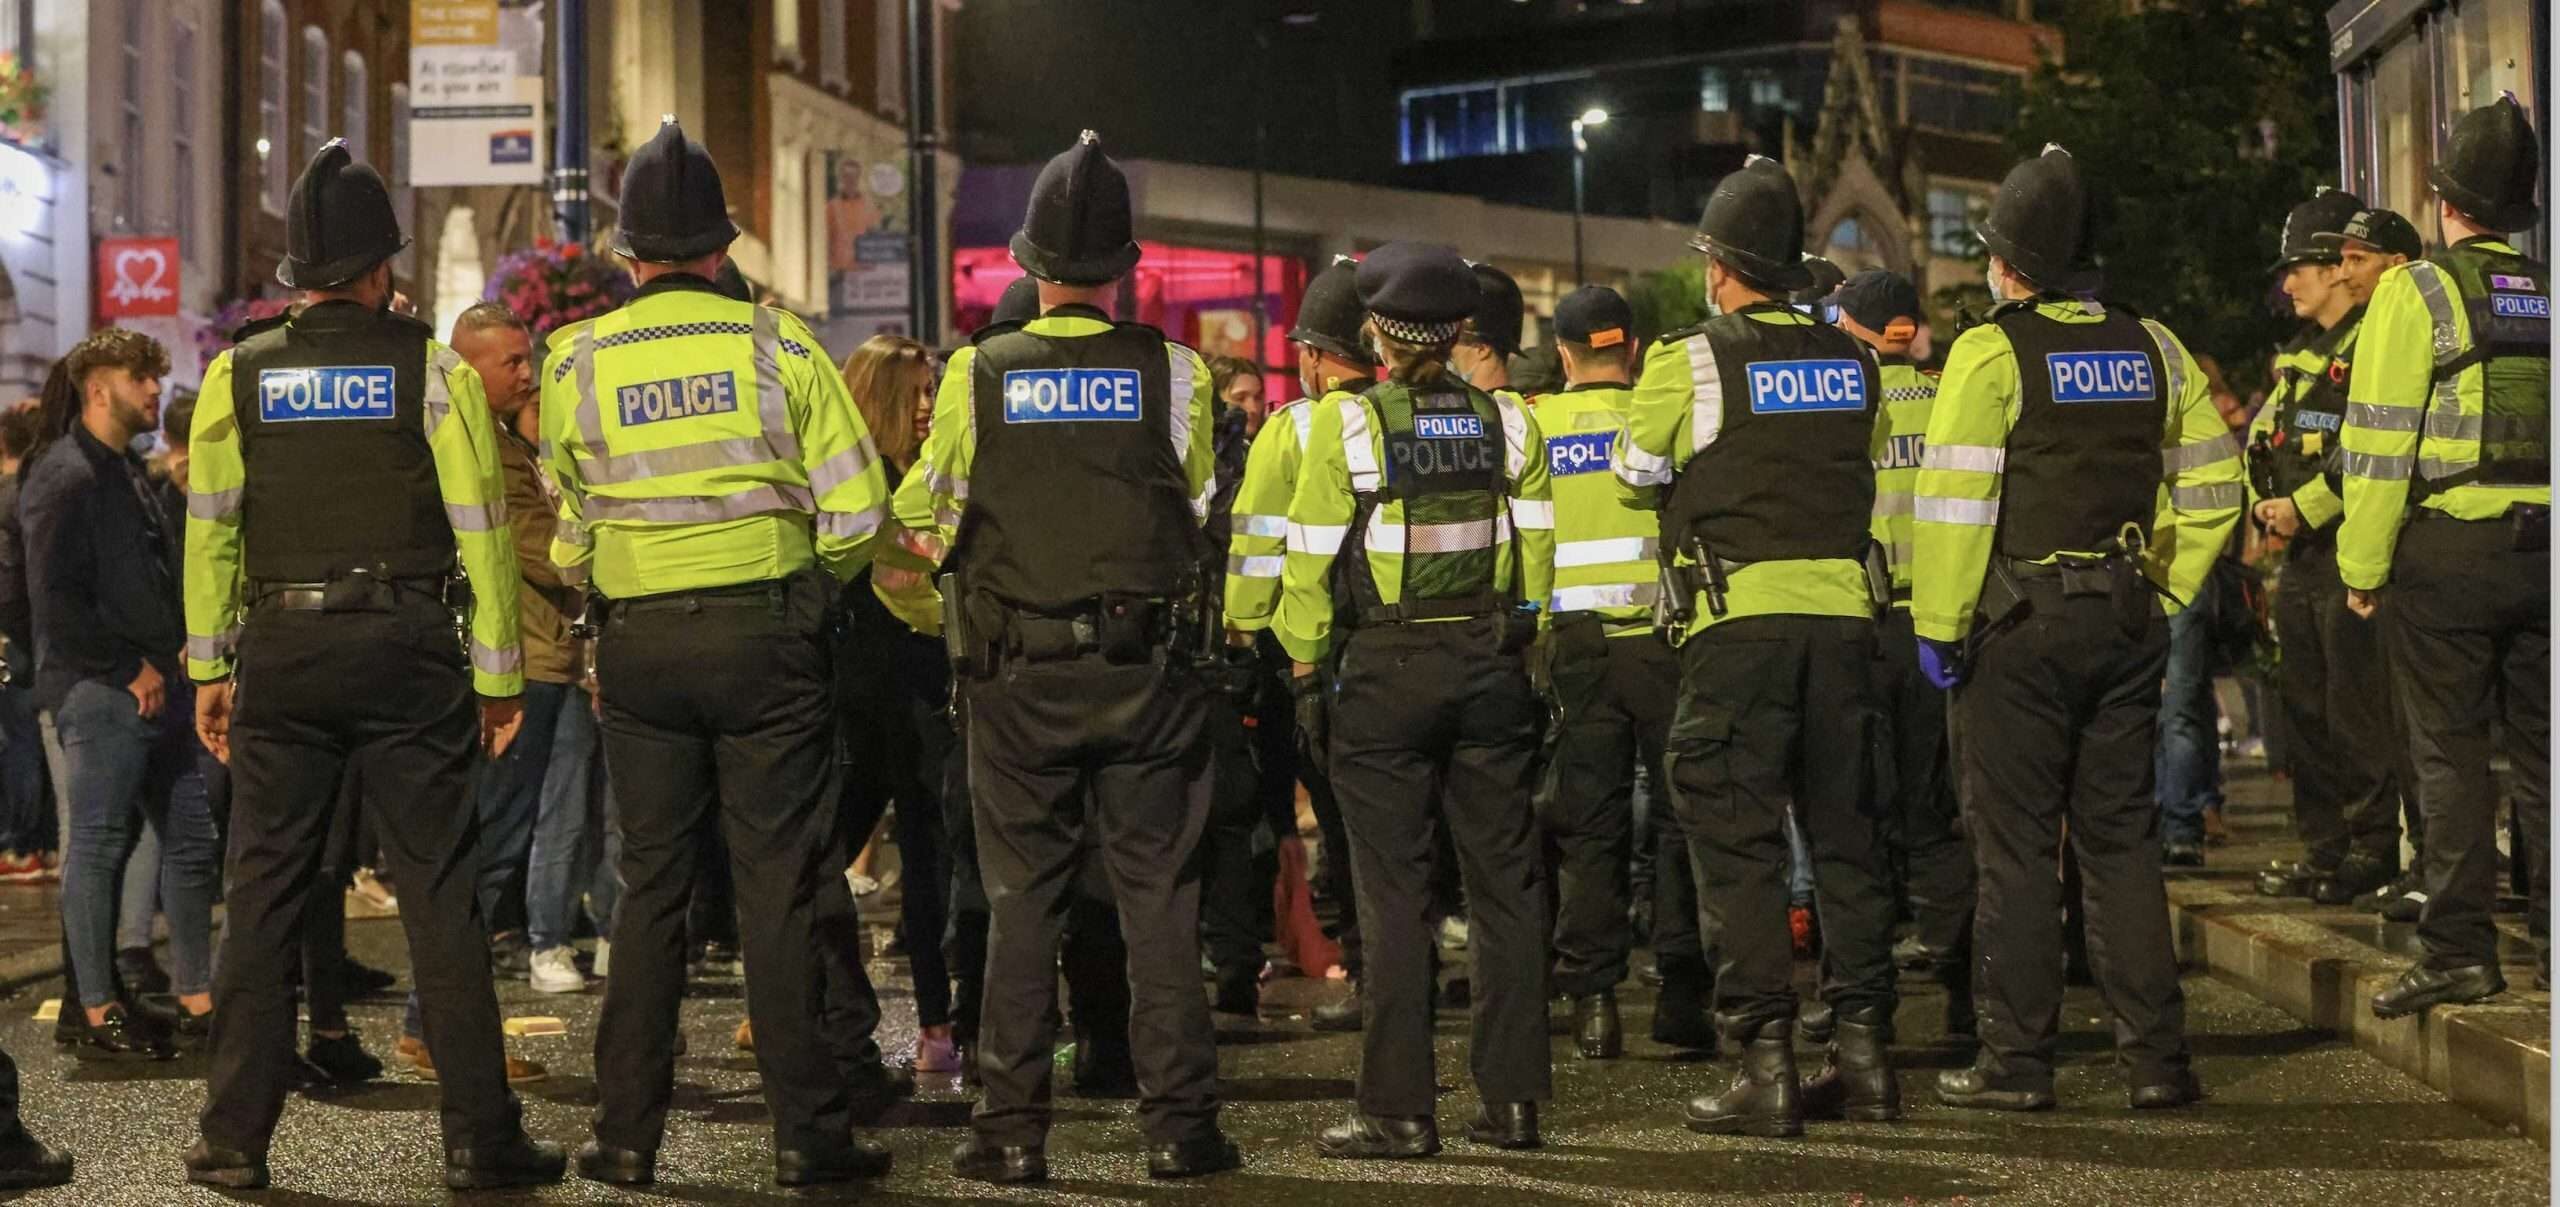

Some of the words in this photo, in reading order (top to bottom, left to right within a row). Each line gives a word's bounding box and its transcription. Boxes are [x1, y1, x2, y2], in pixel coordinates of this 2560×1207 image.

[2495, 297, 2547, 315] POLICE
[264, 375, 388, 411] POLICE
[1754, 368, 1861, 404] POLICE
[2053, 360, 2151, 393] POLICE
[622, 373, 732, 424] POLICE
[1008, 377, 1135, 413] POLICE
[1419, 418, 1479, 435] POLICE
[2299, 413, 2338, 432] POLICE
[1391, 438, 1495, 475] POLICE
[1552, 442, 1612, 469] POLI
[1880, 435, 1926, 469] OLIC
